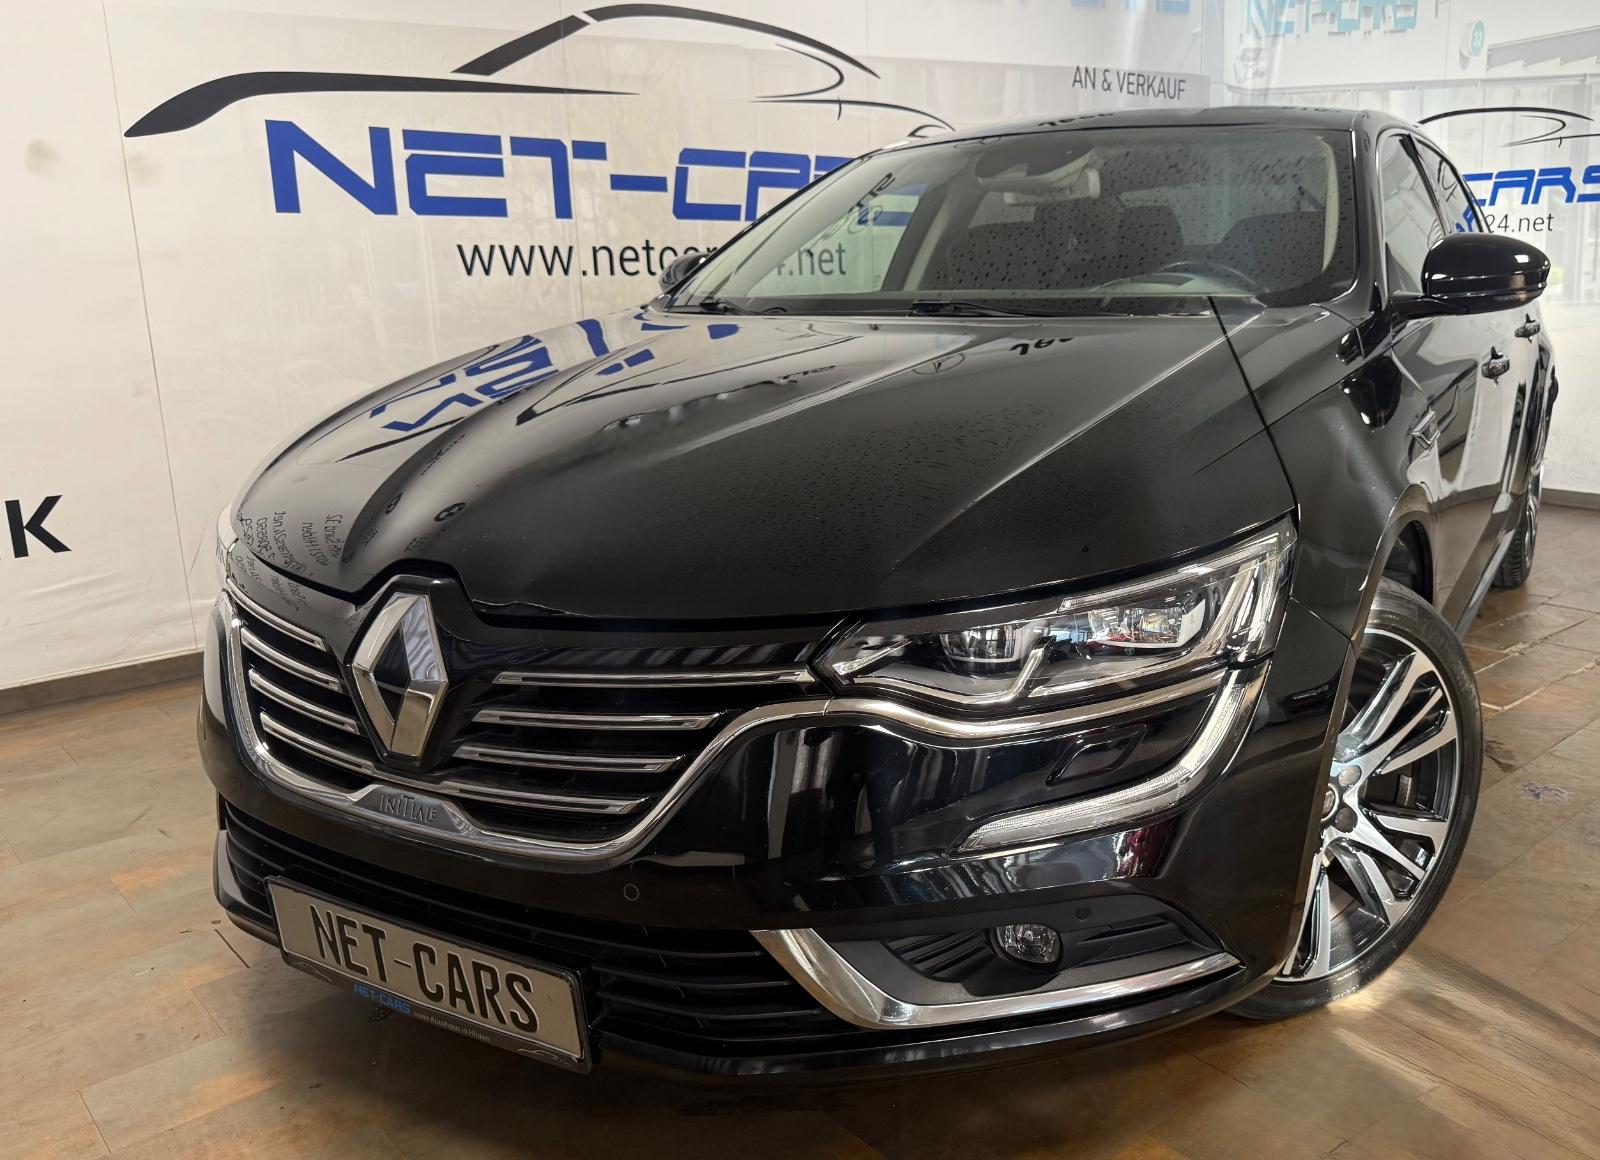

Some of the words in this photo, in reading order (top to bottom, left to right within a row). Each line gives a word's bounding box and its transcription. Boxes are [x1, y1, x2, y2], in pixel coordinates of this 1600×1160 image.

[1072, 65, 1097, 91] AN
[1101, 68, 1112, 92] &
[1116, 71, 1187, 101] VERKAUF
[308, 903, 540, 1034] NET-CARS
